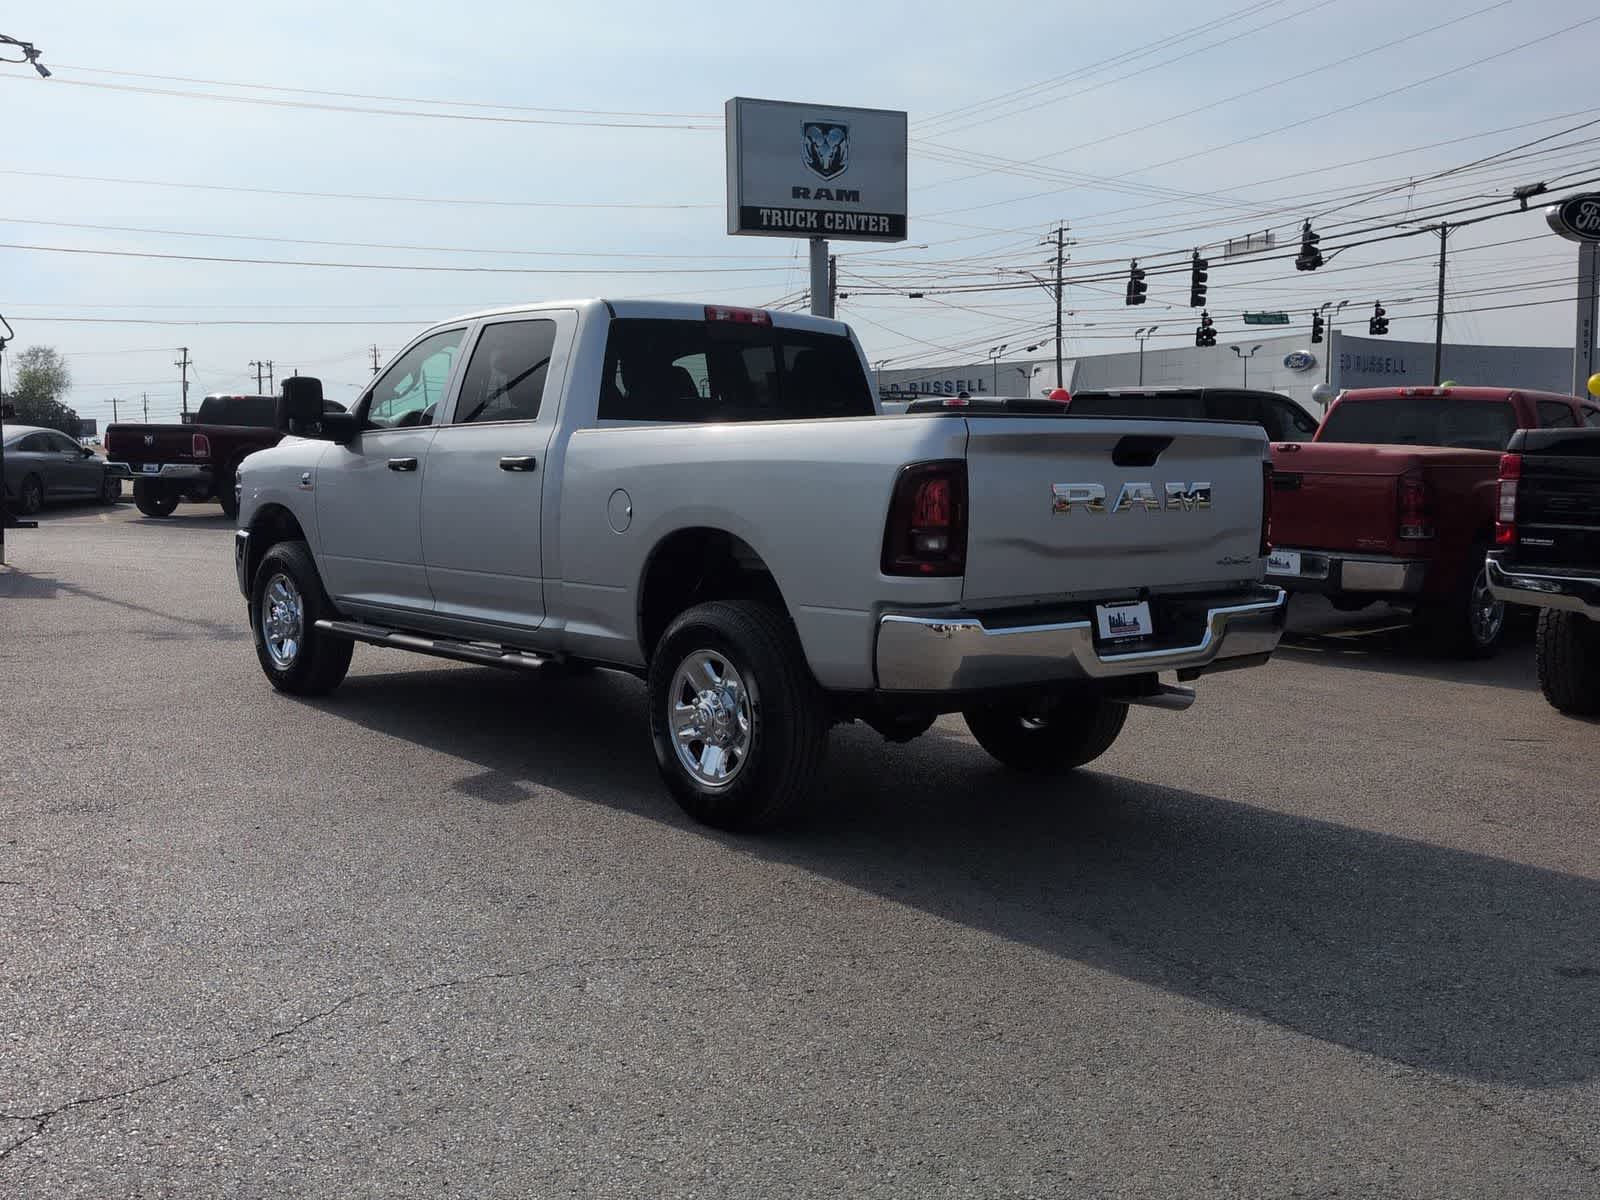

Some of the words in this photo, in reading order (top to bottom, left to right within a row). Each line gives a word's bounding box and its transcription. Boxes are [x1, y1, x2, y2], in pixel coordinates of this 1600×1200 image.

[791, 186, 860, 202] RAM
[759, 208, 818, 229] TRUCK
[823, 211, 890, 233] CENTER
[1354, 354, 1407, 374] RUSSELL
[909, 378, 988, 393] RUSSELL
[1051, 481, 1212, 515] RAM
